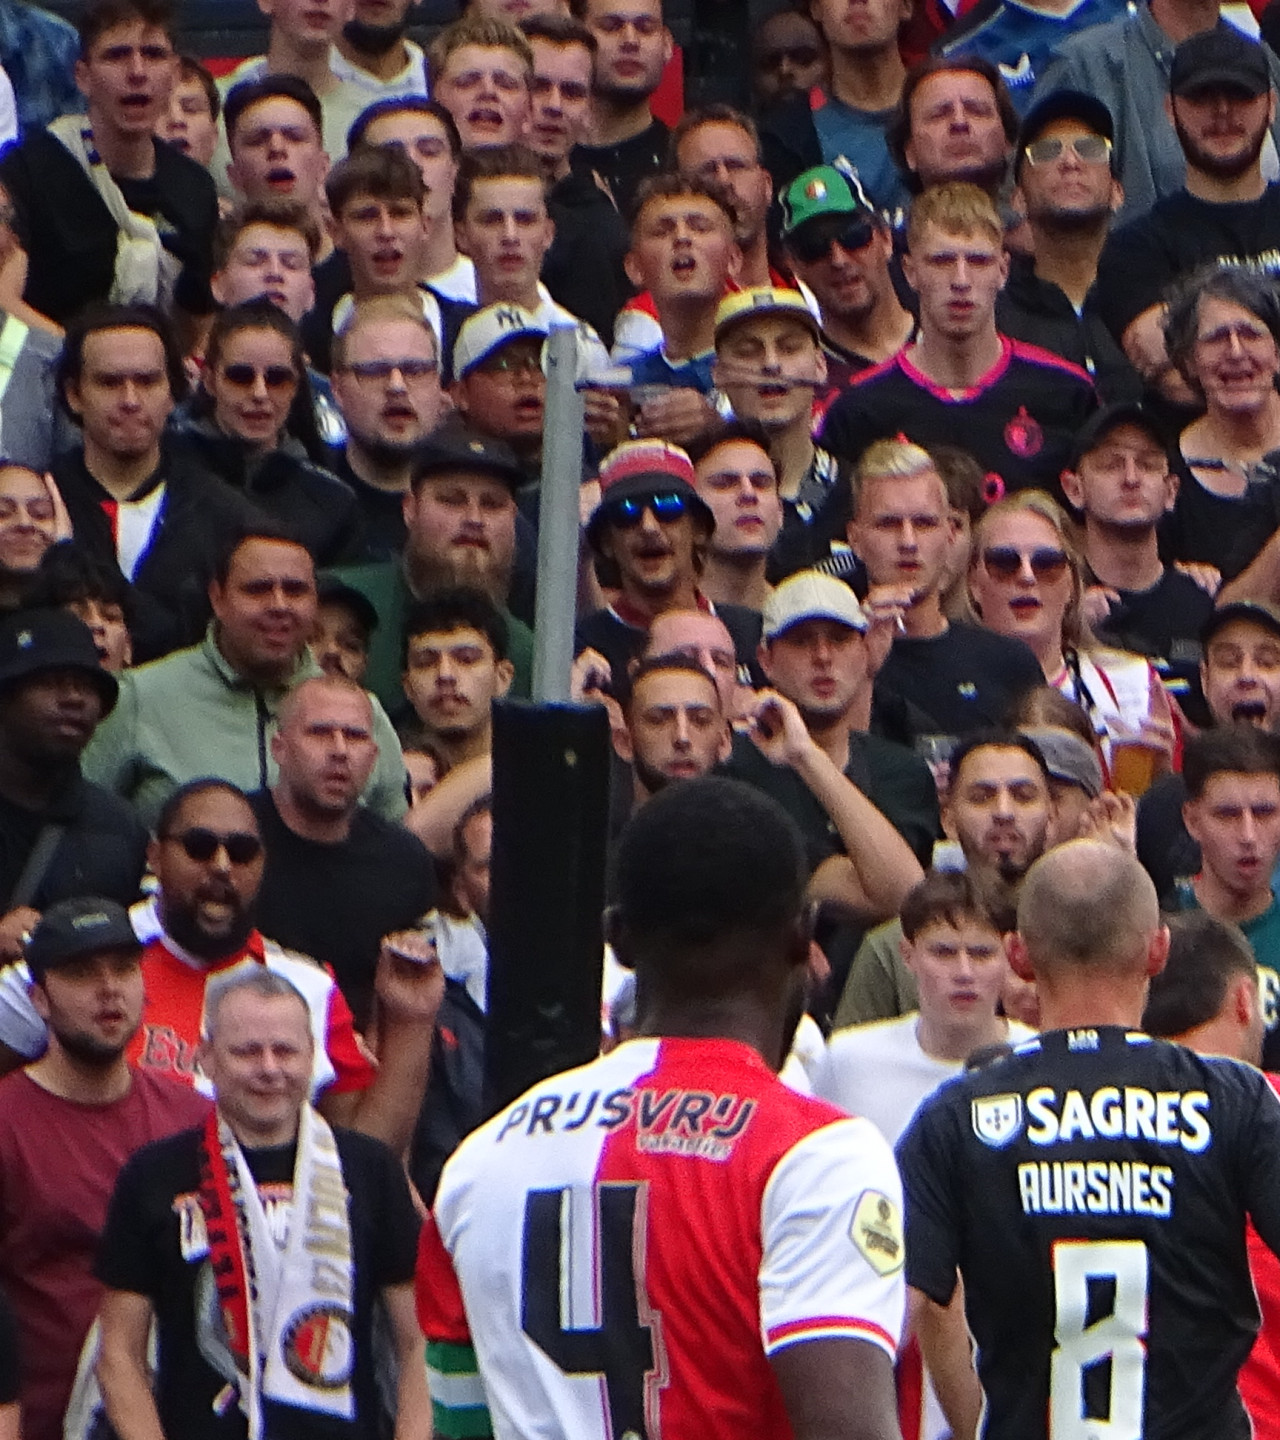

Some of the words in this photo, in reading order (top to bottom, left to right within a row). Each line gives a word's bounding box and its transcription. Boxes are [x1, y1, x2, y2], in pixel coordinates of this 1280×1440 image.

[138, 1024, 198, 1073] Eu
[1026, 1086, 1212, 1155] SAGRES
[1018, 1161, 1174, 1218] AURSNES
